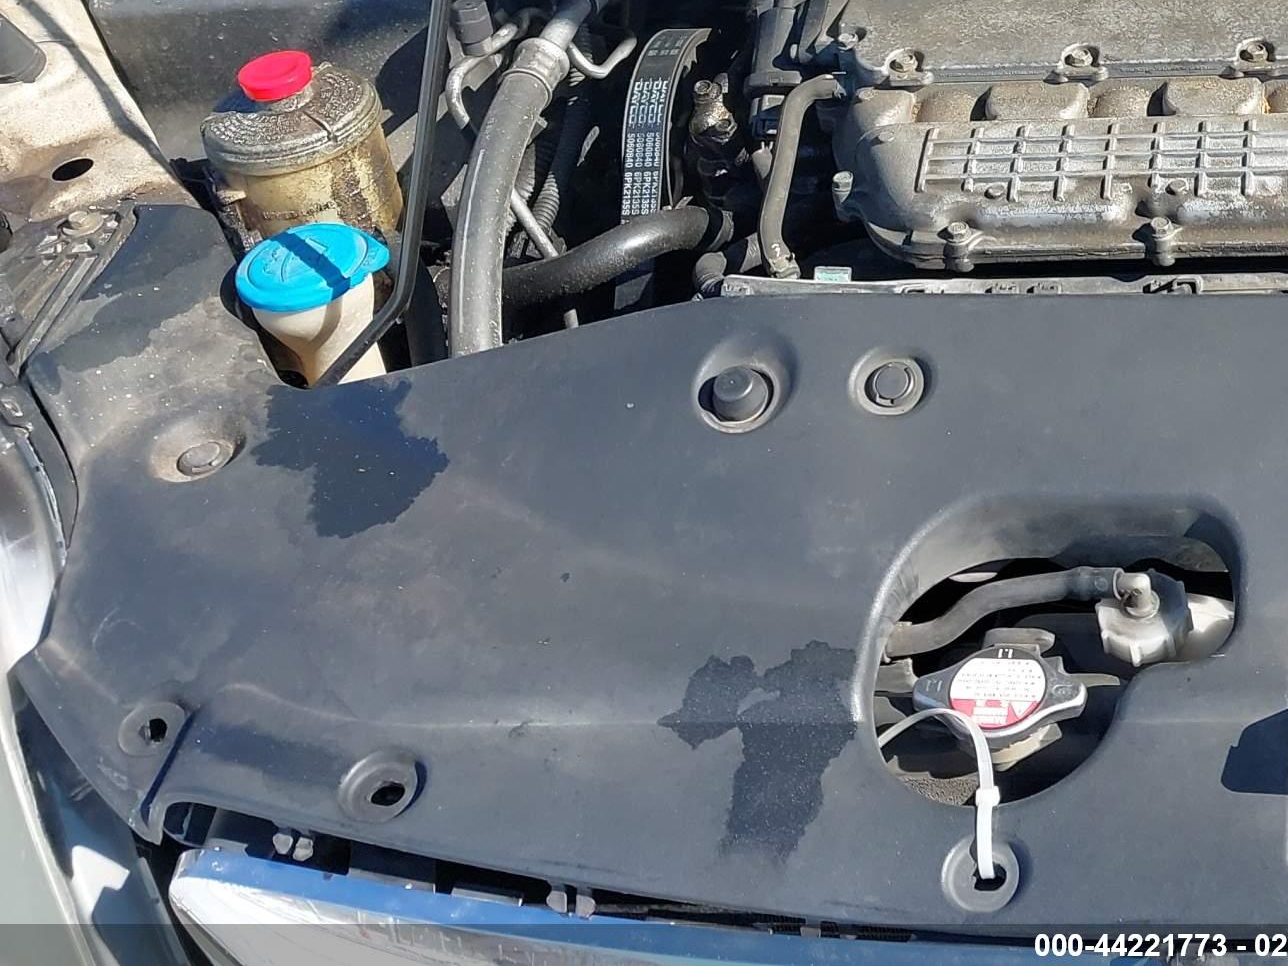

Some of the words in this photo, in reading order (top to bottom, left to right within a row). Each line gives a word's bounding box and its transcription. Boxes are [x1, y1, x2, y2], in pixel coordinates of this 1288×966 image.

[628, 81, 643, 124] DAYCO
[638, 81, 652, 124] DAYCO
[647, 80, 662, 124] DAYCO
[625, 133, 636, 168] 5060840
[635, 133, 646, 168] 5060840
[644, 132, 655, 168] 5060840
[621, 172, 633, 216] 6PK2135S
[631, 172, 643, 216] 6PK2135S
[641, 171, 653, 215] 6PK2135S
